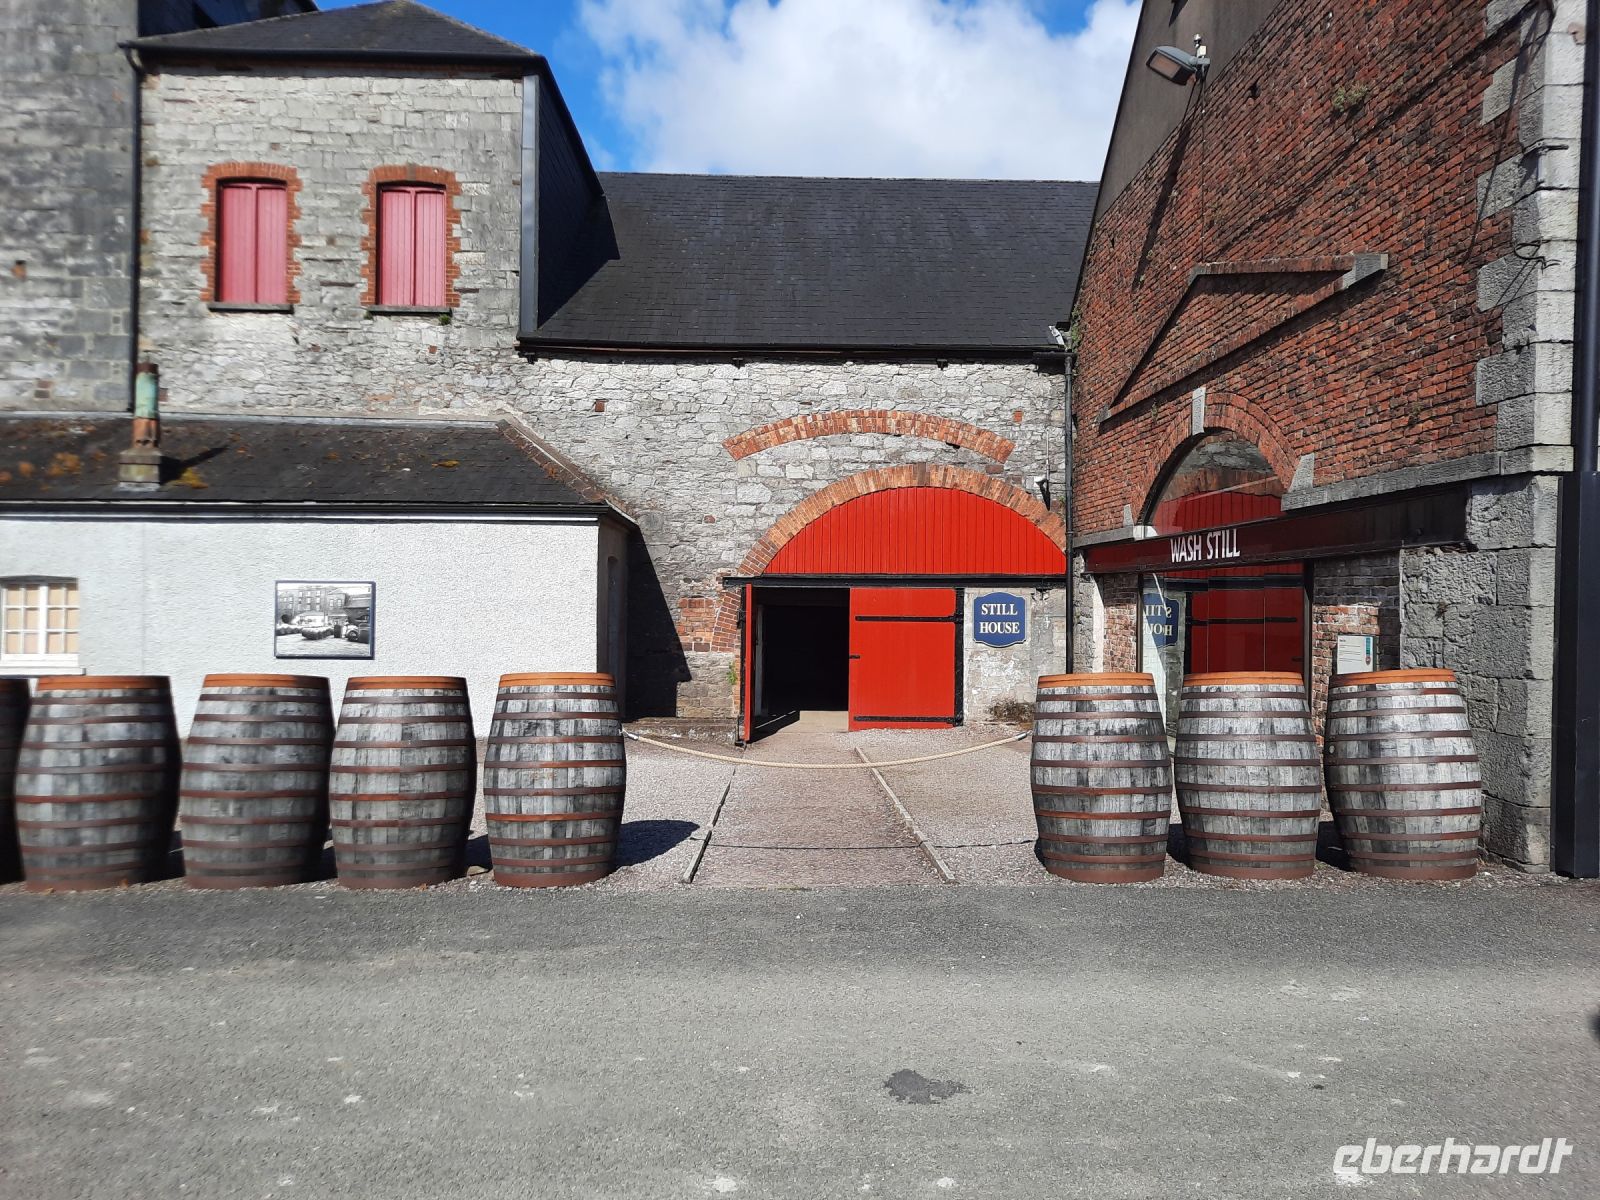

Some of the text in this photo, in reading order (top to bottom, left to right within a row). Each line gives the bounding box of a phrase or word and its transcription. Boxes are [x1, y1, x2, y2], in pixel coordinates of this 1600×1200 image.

[1170, 528, 1240, 563] WASH STILL
[981, 603, 1018, 615] STILL
[979, 621, 1020, 634] HOUSE
